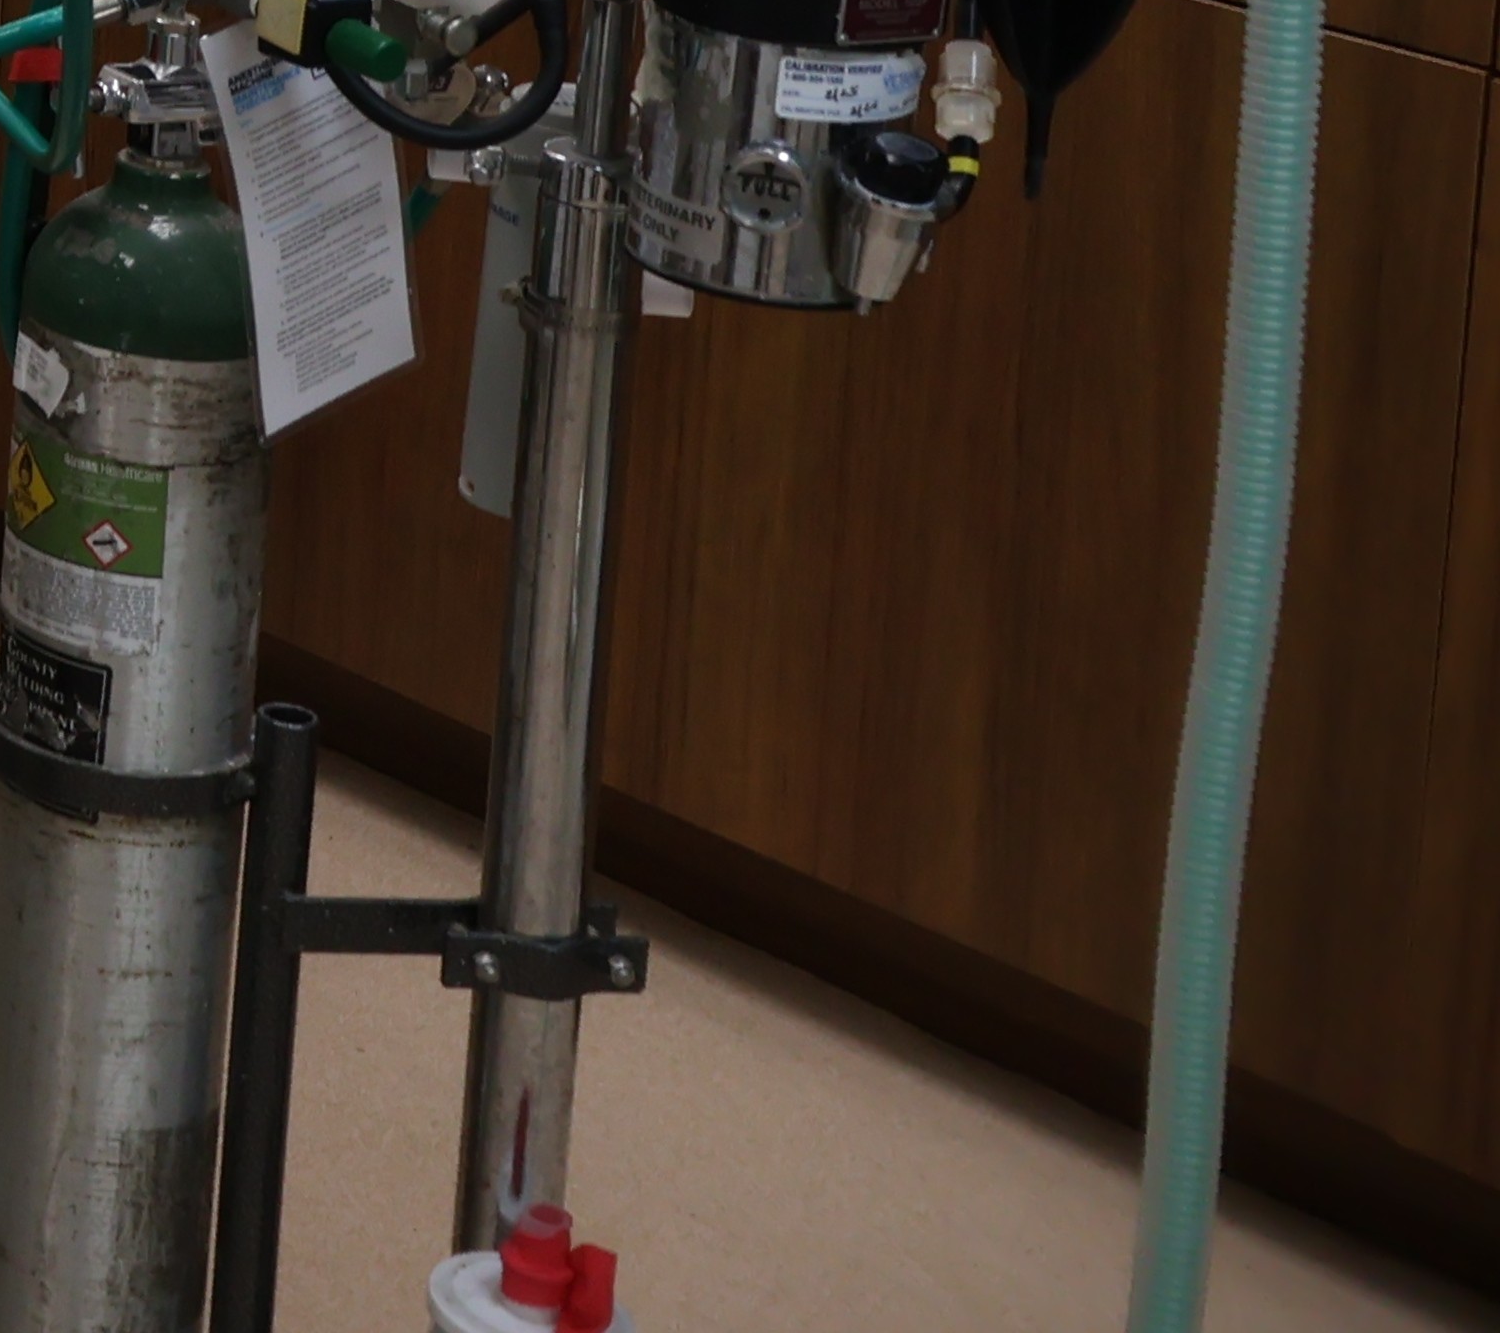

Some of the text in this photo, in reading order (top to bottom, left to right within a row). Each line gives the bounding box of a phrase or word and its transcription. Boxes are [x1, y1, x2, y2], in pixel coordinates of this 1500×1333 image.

[785, 60, 846, 74] CALIBRATION
[739, 172, 792, 202] FULL
[641, 214, 680, 242] ONLY
